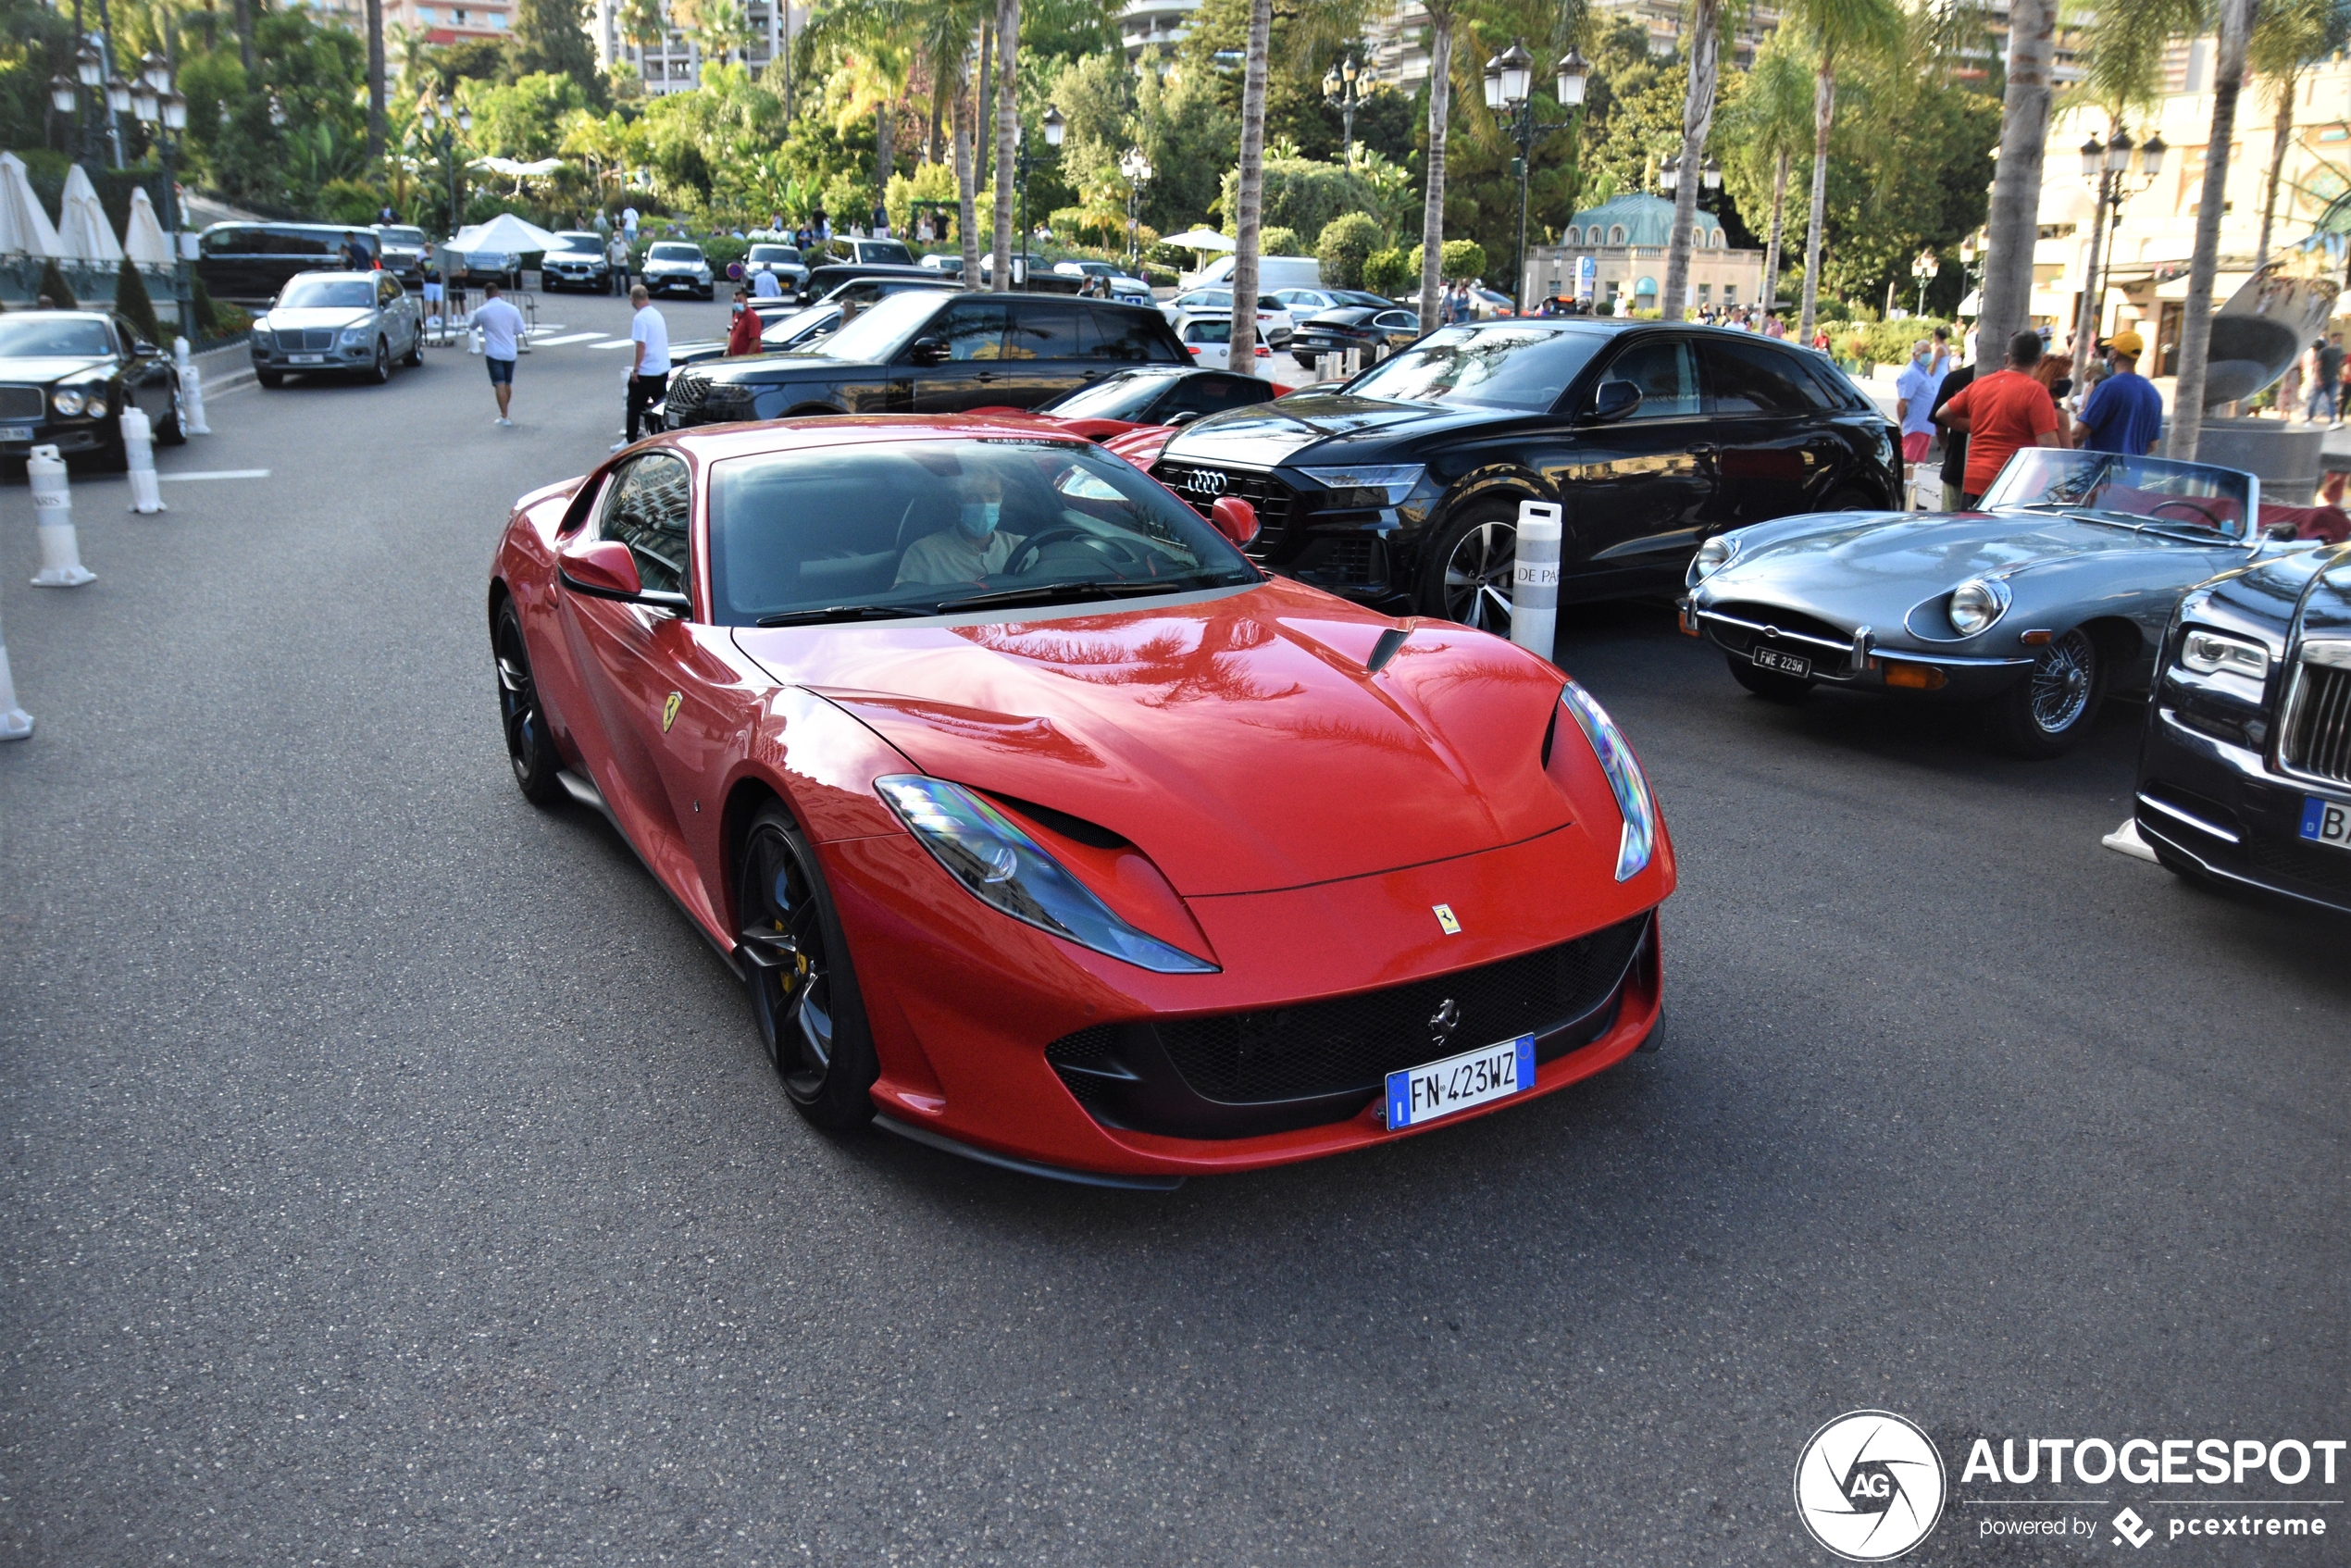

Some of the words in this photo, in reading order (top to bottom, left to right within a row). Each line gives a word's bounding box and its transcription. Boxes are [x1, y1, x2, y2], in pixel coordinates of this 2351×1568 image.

[1518, 567, 1536, 582] DE
[1760, 651, 1777, 666] FWE
[1411, 1073, 1440, 1113] FN
[1448, 1052, 1515, 1101] 423WZ
